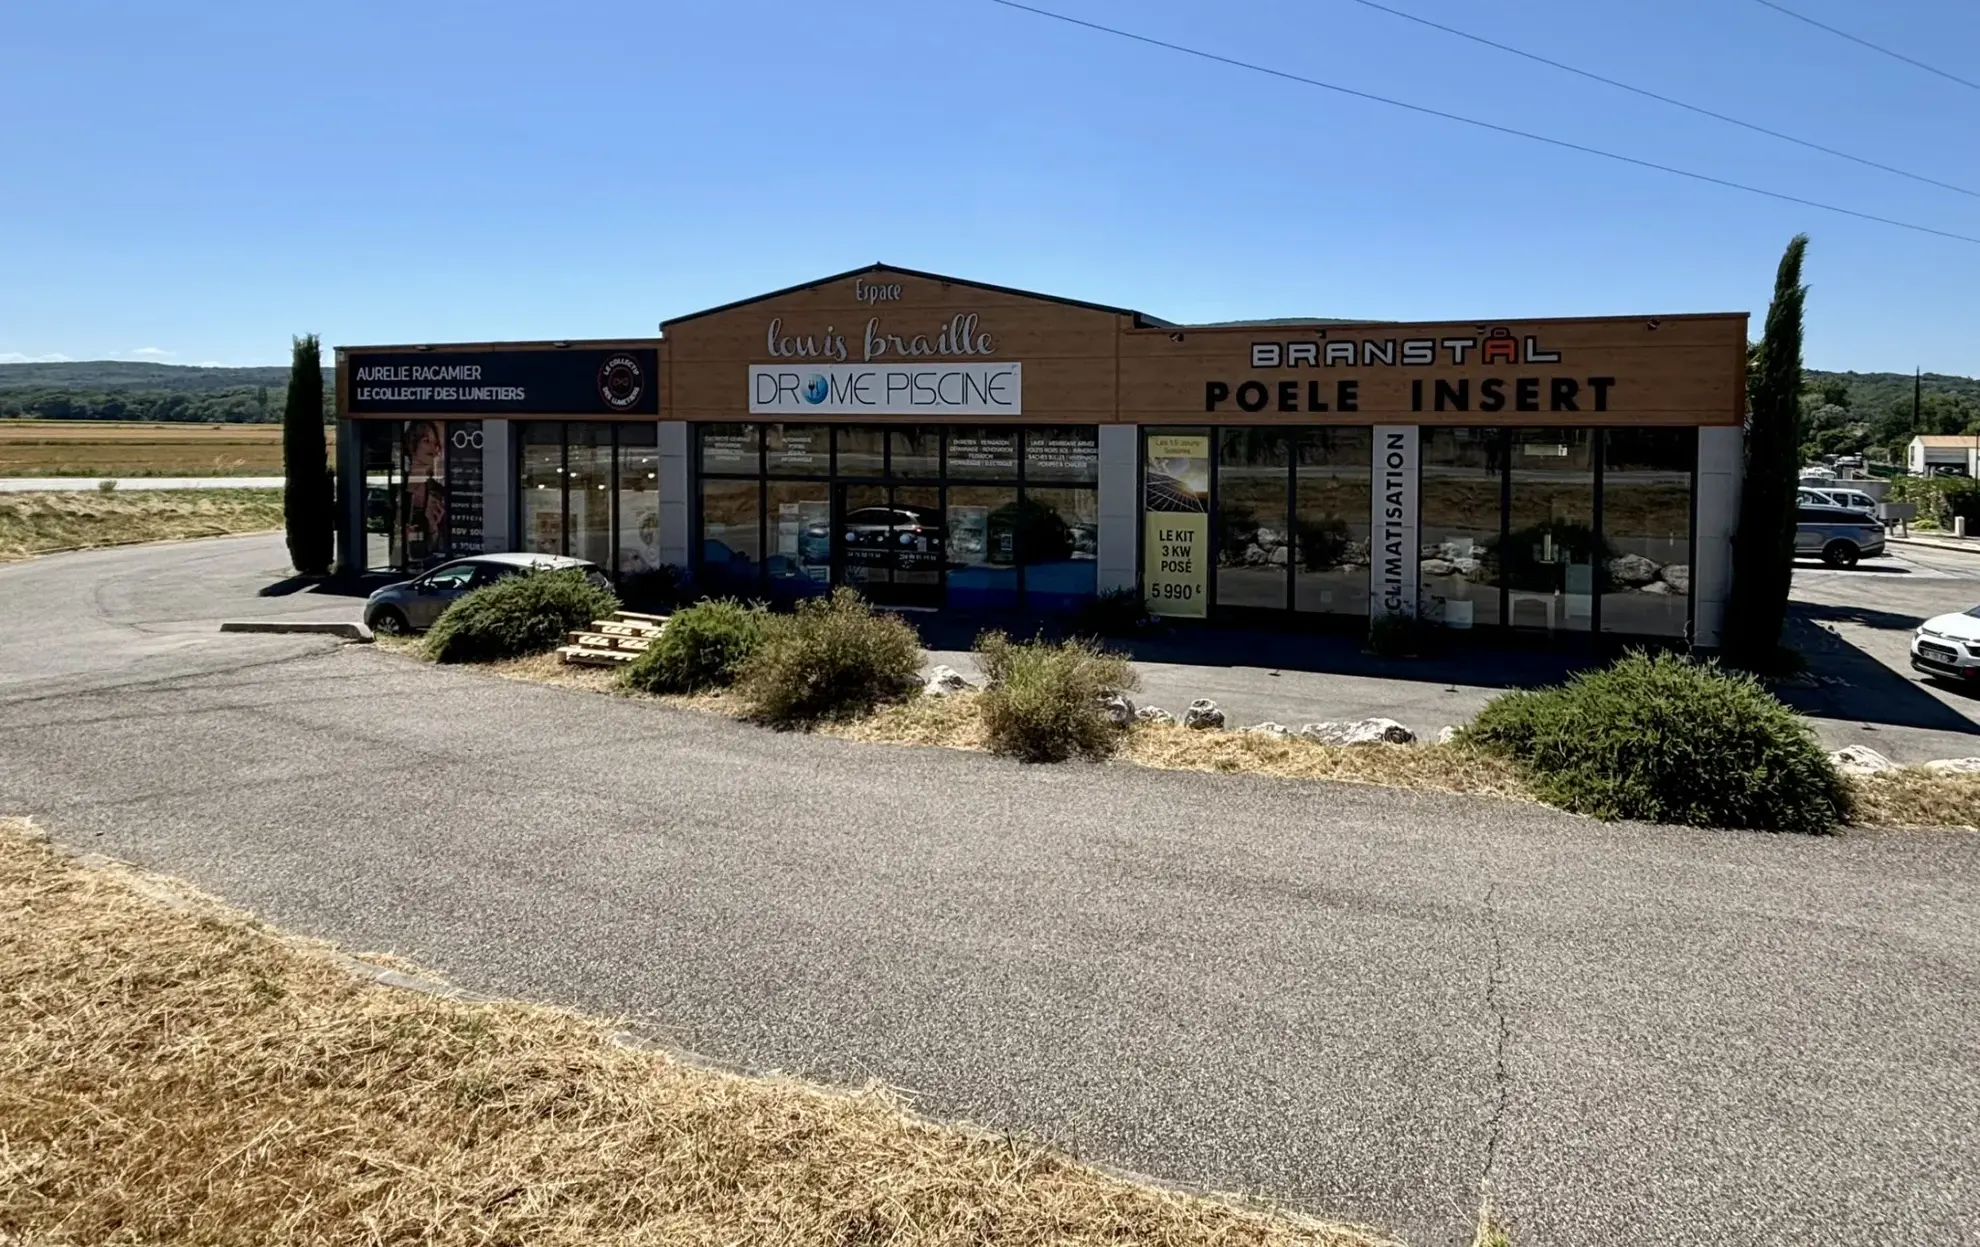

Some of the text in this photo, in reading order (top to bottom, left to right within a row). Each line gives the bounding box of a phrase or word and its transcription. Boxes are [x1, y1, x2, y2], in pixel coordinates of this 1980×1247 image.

[856, 279, 901, 304] Espace
[767, 313, 996, 361] louis braille
[357, 365, 481, 381] AURELIE RACAMIER
[610, 358, 639, 375] COLLECTIF
[357, 387, 525, 400] LE COLLECTIF DES LUNETIERS
[887, 372, 1012, 405] PISCINE
[1205, 377, 1615, 413] POELE INSERT
[1384, 432, 1405, 611] CLIMATISATION
[451, 527, 467, 535] RDV
[1159, 529, 1194, 542] LE KIT
[1162, 545, 1191, 557] 3 KW
[1161, 559, 1192, 573] POSÉ
[1151, 583, 1161, 599] 5
[1164, 583, 1192, 600] 990
